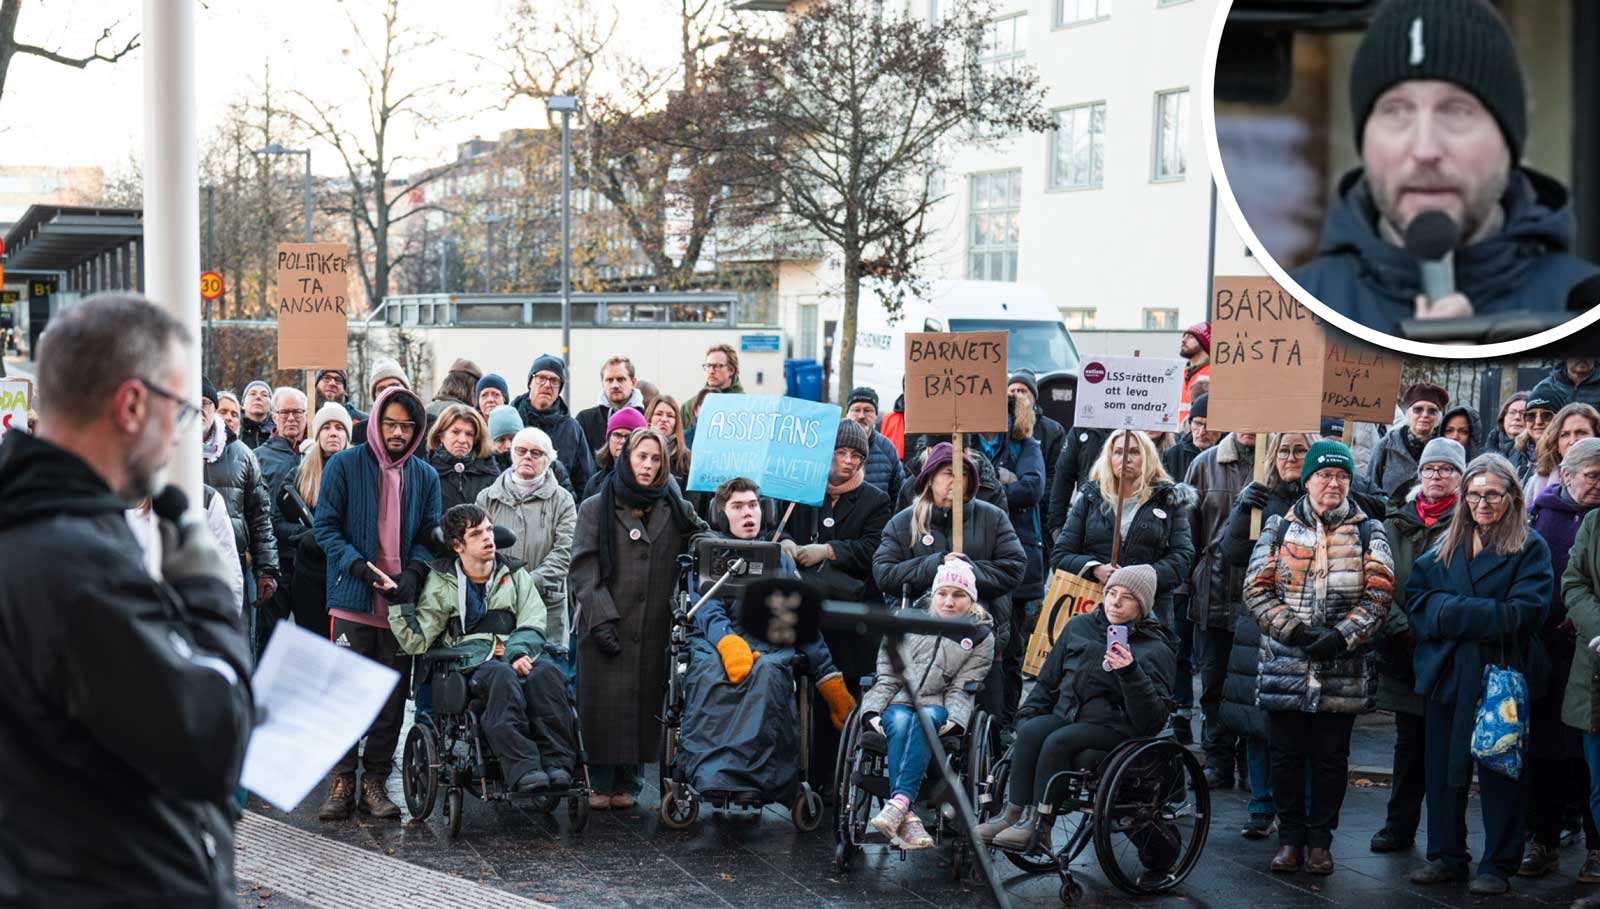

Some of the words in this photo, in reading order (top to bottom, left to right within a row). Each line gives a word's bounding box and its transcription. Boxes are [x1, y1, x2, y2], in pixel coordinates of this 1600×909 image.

[278, 251, 347, 275] POLITIKER
[201, 279, 221, 292] 30
[298, 278, 323, 294] TA
[280, 296, 346, 316] ANSVAR
[1216, 288, 1321, 324] BARNE
[909, 339, 1001, 363] BARNETS
[1215, 331, 1301, 366] BÄSTA
[1327, 344, 1384, 368] ALLA
[925, 368, 993, 398] BÄSTA
[1106, 371, 1165, 384] LSS=rätten
[0, 390, 28, 412] DA
[1105, 386, 1121, 396] att
[1126, 386, 1149, 397] leva
[1104, 401, 1126, 410] som
[1130, 401, 1167, 413] andra?
[707, 411, 821, 449] ASSISTANS
